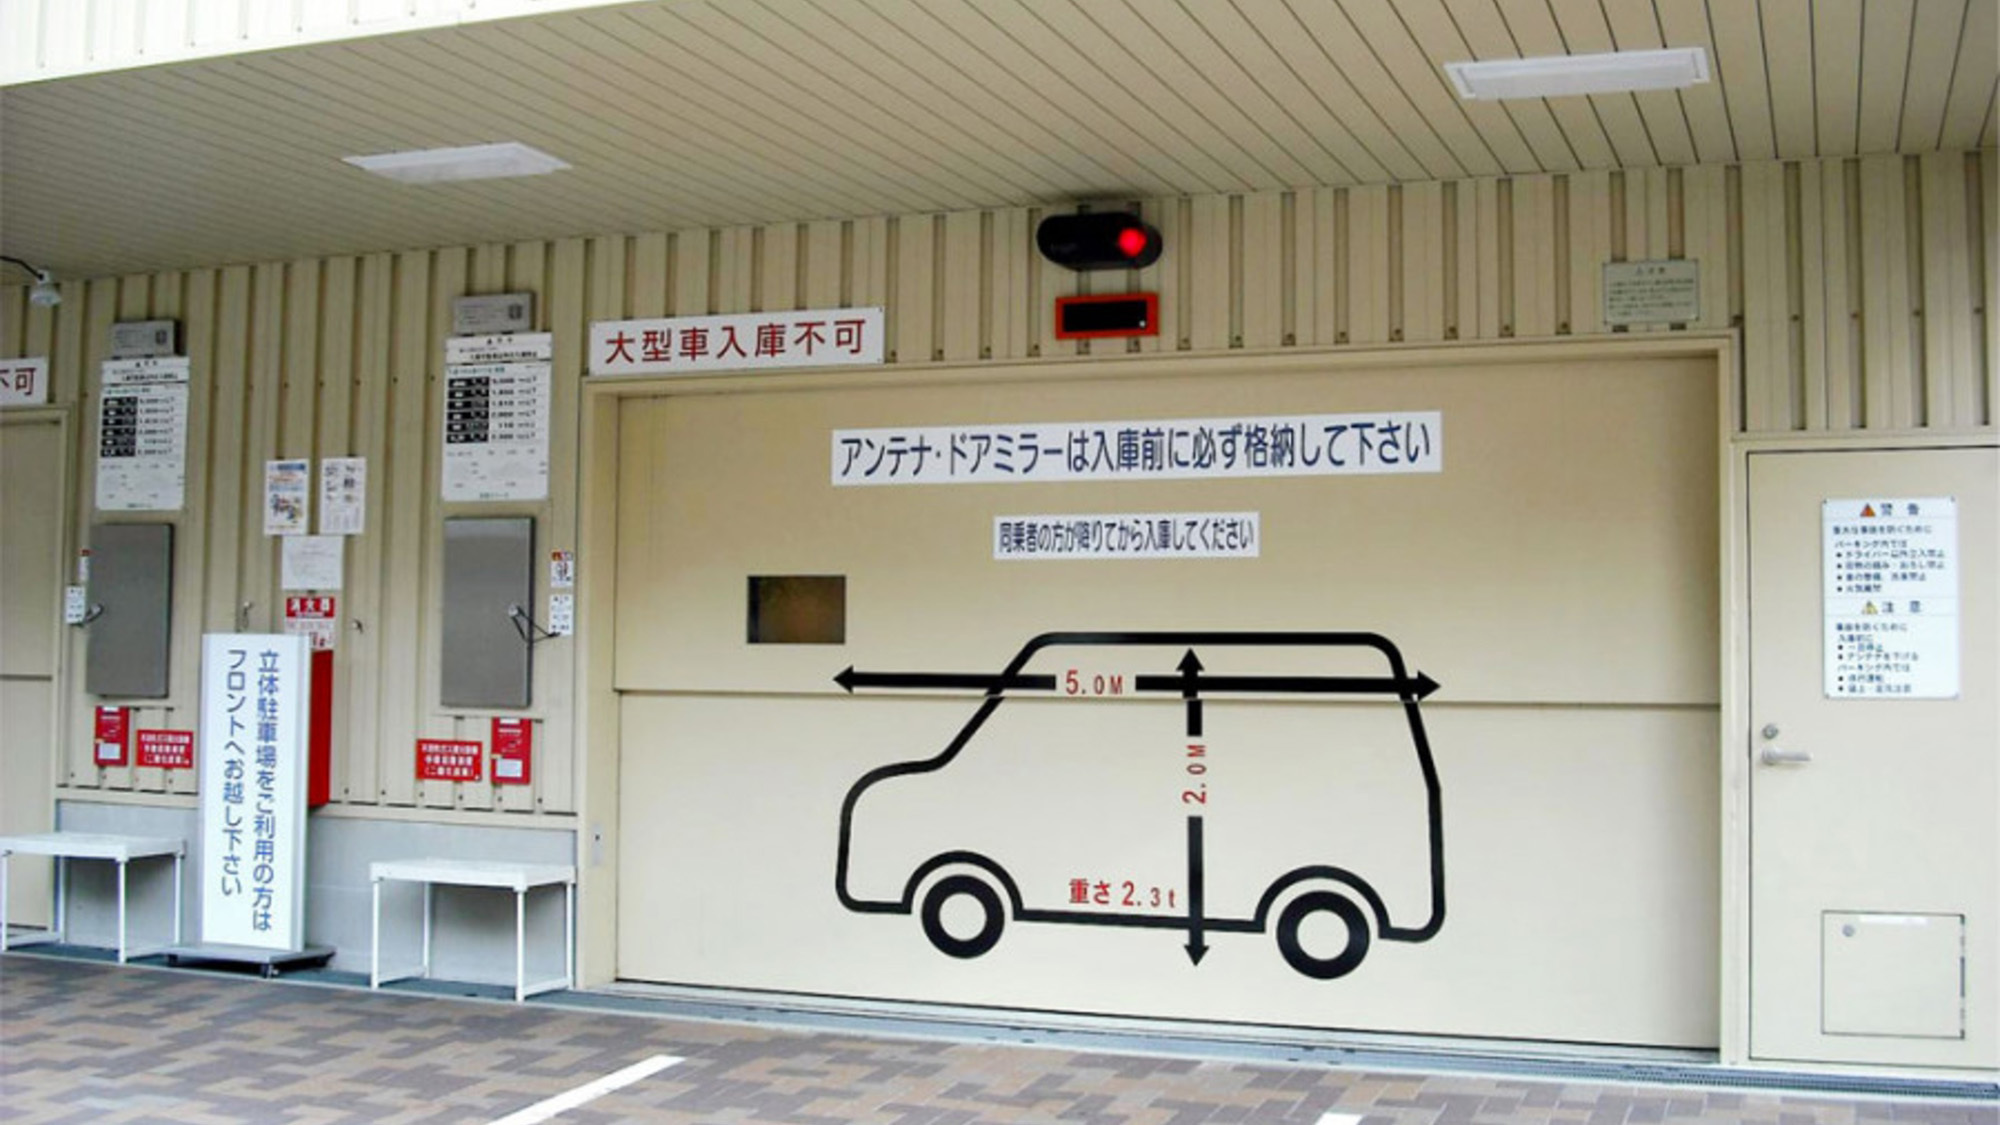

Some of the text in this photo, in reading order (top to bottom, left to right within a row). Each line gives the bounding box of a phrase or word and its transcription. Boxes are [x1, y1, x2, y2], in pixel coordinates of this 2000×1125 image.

[605, 319, 866, 364] 大型車入庫不可
[840, 420, 1430, 476] アンテナ・ドアミラーは入庫前に必ず格納して下さい
[1000, 519, 1254, 553] 同乗者の方が降りてから入庫してください
[1066, 669, 1123, 695] 5.0M
[222, 650, 246, 896] フロントへお越し下さい
[252, 648, 280, 931] 立体駐車場をご利用の方は
[1181, 745, 1207, 804] 2.0M
